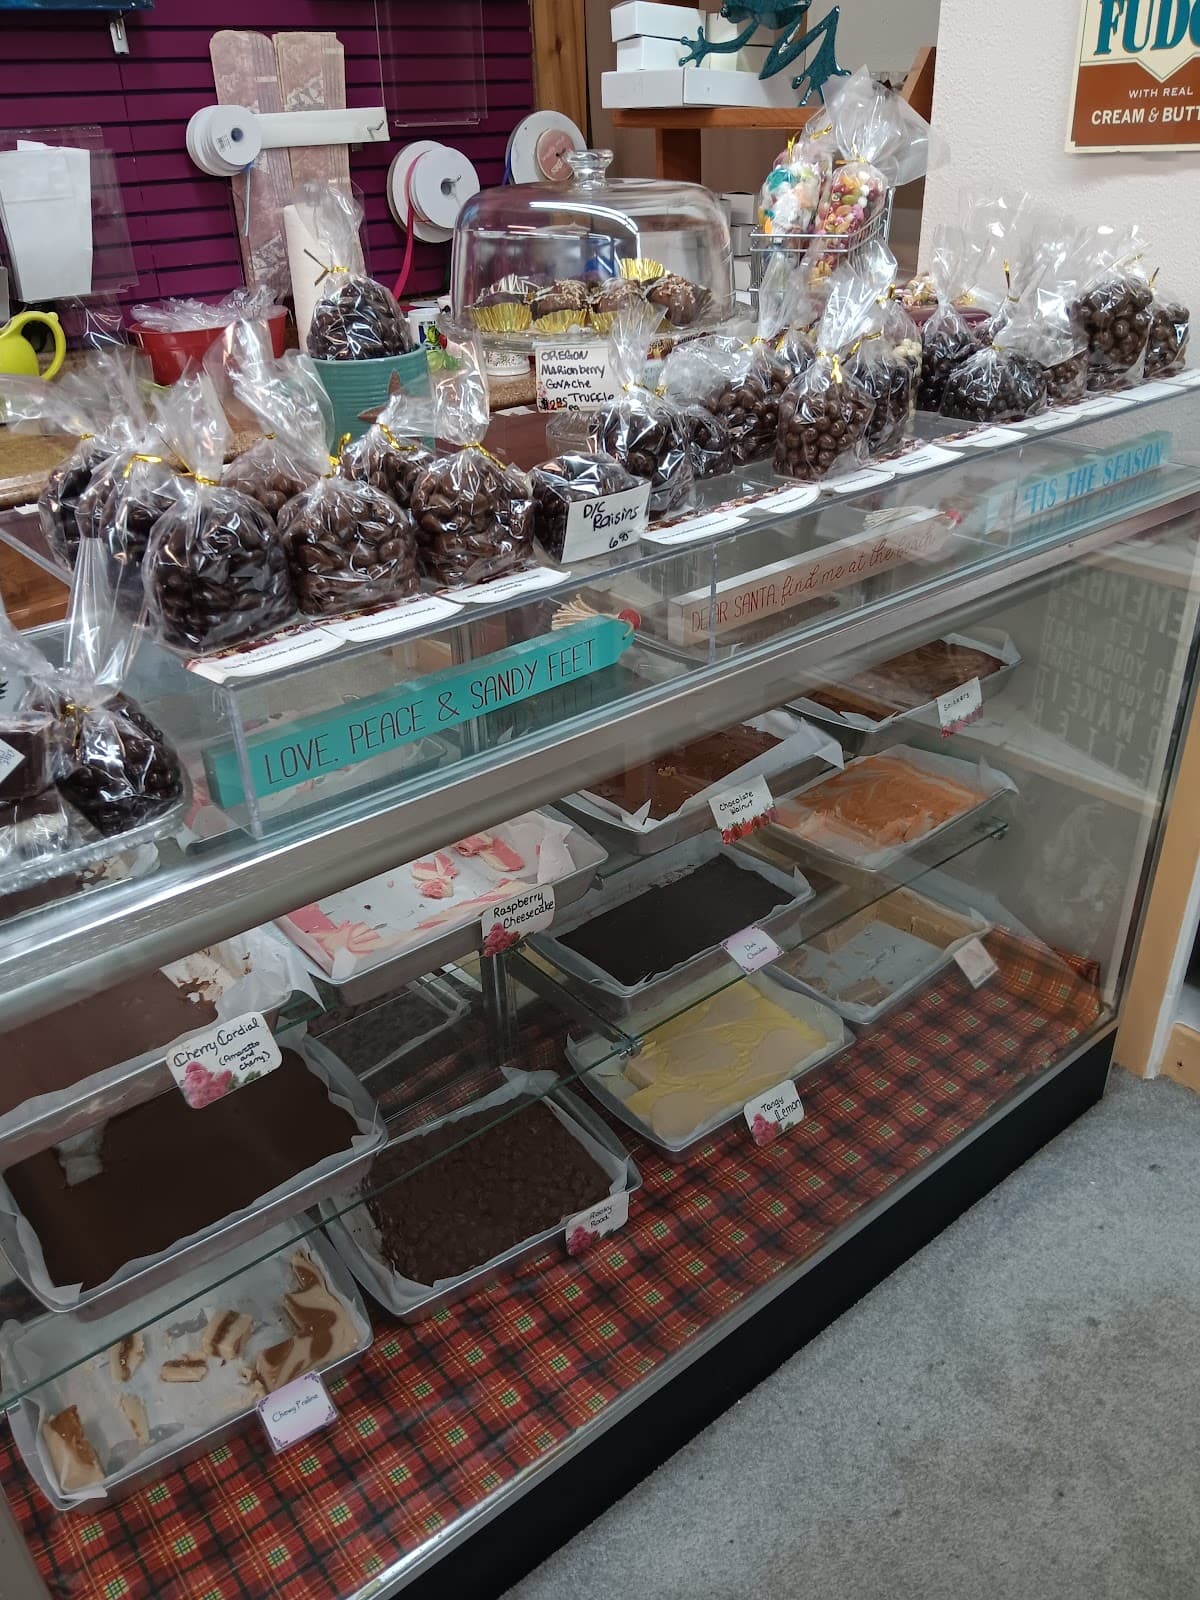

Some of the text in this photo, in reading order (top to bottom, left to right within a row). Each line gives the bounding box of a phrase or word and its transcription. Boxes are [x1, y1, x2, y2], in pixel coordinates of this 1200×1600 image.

[1093, 0, 1200, 56] FUD
[1128, 86, 1193, 98] WITH REAL
[1091, 108, 1144, 125] CREAM
[1148, 107, 1159, 123] &
[541, 350, 588, 361] OREGON
[1065, 463, 1098, 501] THE
[1103, 440, 1164, 486] SEASON
[583, 502, 605, 519] D/C
[593, 506, 639, 531] Raisins
[780, 564, 820, 608] find
[822, 565, 844, 583] me
[848, 551, 866, 574] at
[868, 538, 894, 566] the
[349, 700, 426, 754] PEACE
[438, 692, 460, 722] &
[470, 659, 538, 710] SANDY
[549, 638, 596, 681] FEET
[720, 792, 754, 811] Chocolate
[494, 893, 544, 918] Raspberry
[504, 901, 554, 929] Cheesecake
[173, 1017, 259, 1067] Cherry Cordial
[240, 1050, 255, 1061] and
[761, 1097, 784, 1112] Tangy
[774, 1099, 801, 1121] Lemon
[591, 1215, 609, 1228] Road
